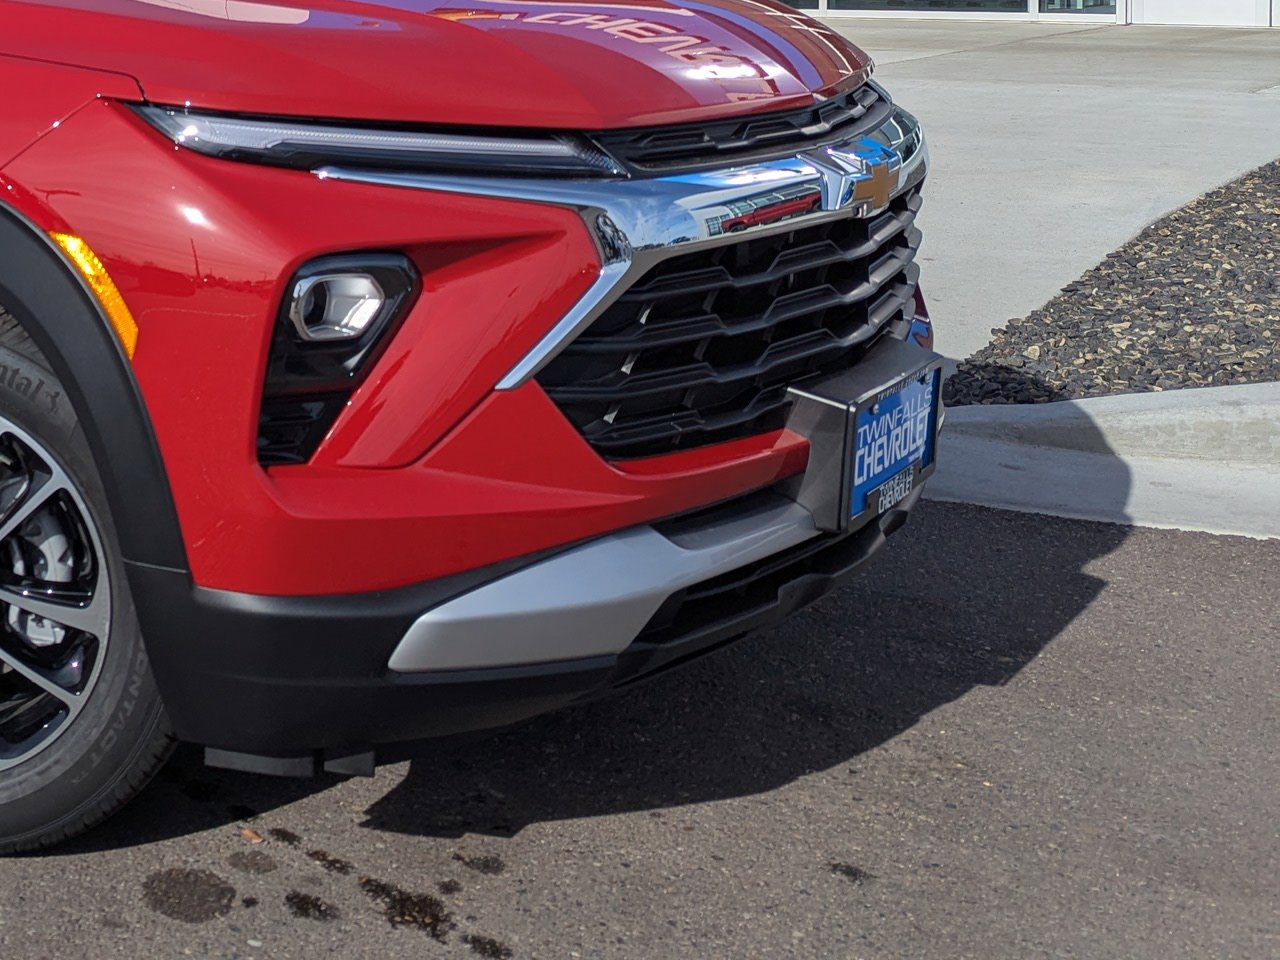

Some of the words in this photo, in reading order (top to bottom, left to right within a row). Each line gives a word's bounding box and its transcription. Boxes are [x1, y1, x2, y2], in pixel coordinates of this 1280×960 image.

[854, 406, 931, 487] CHEVROLET
[857, 386, 933, 449] TWINFALLS
[878, 480, 913, 515] CHEVROLET
